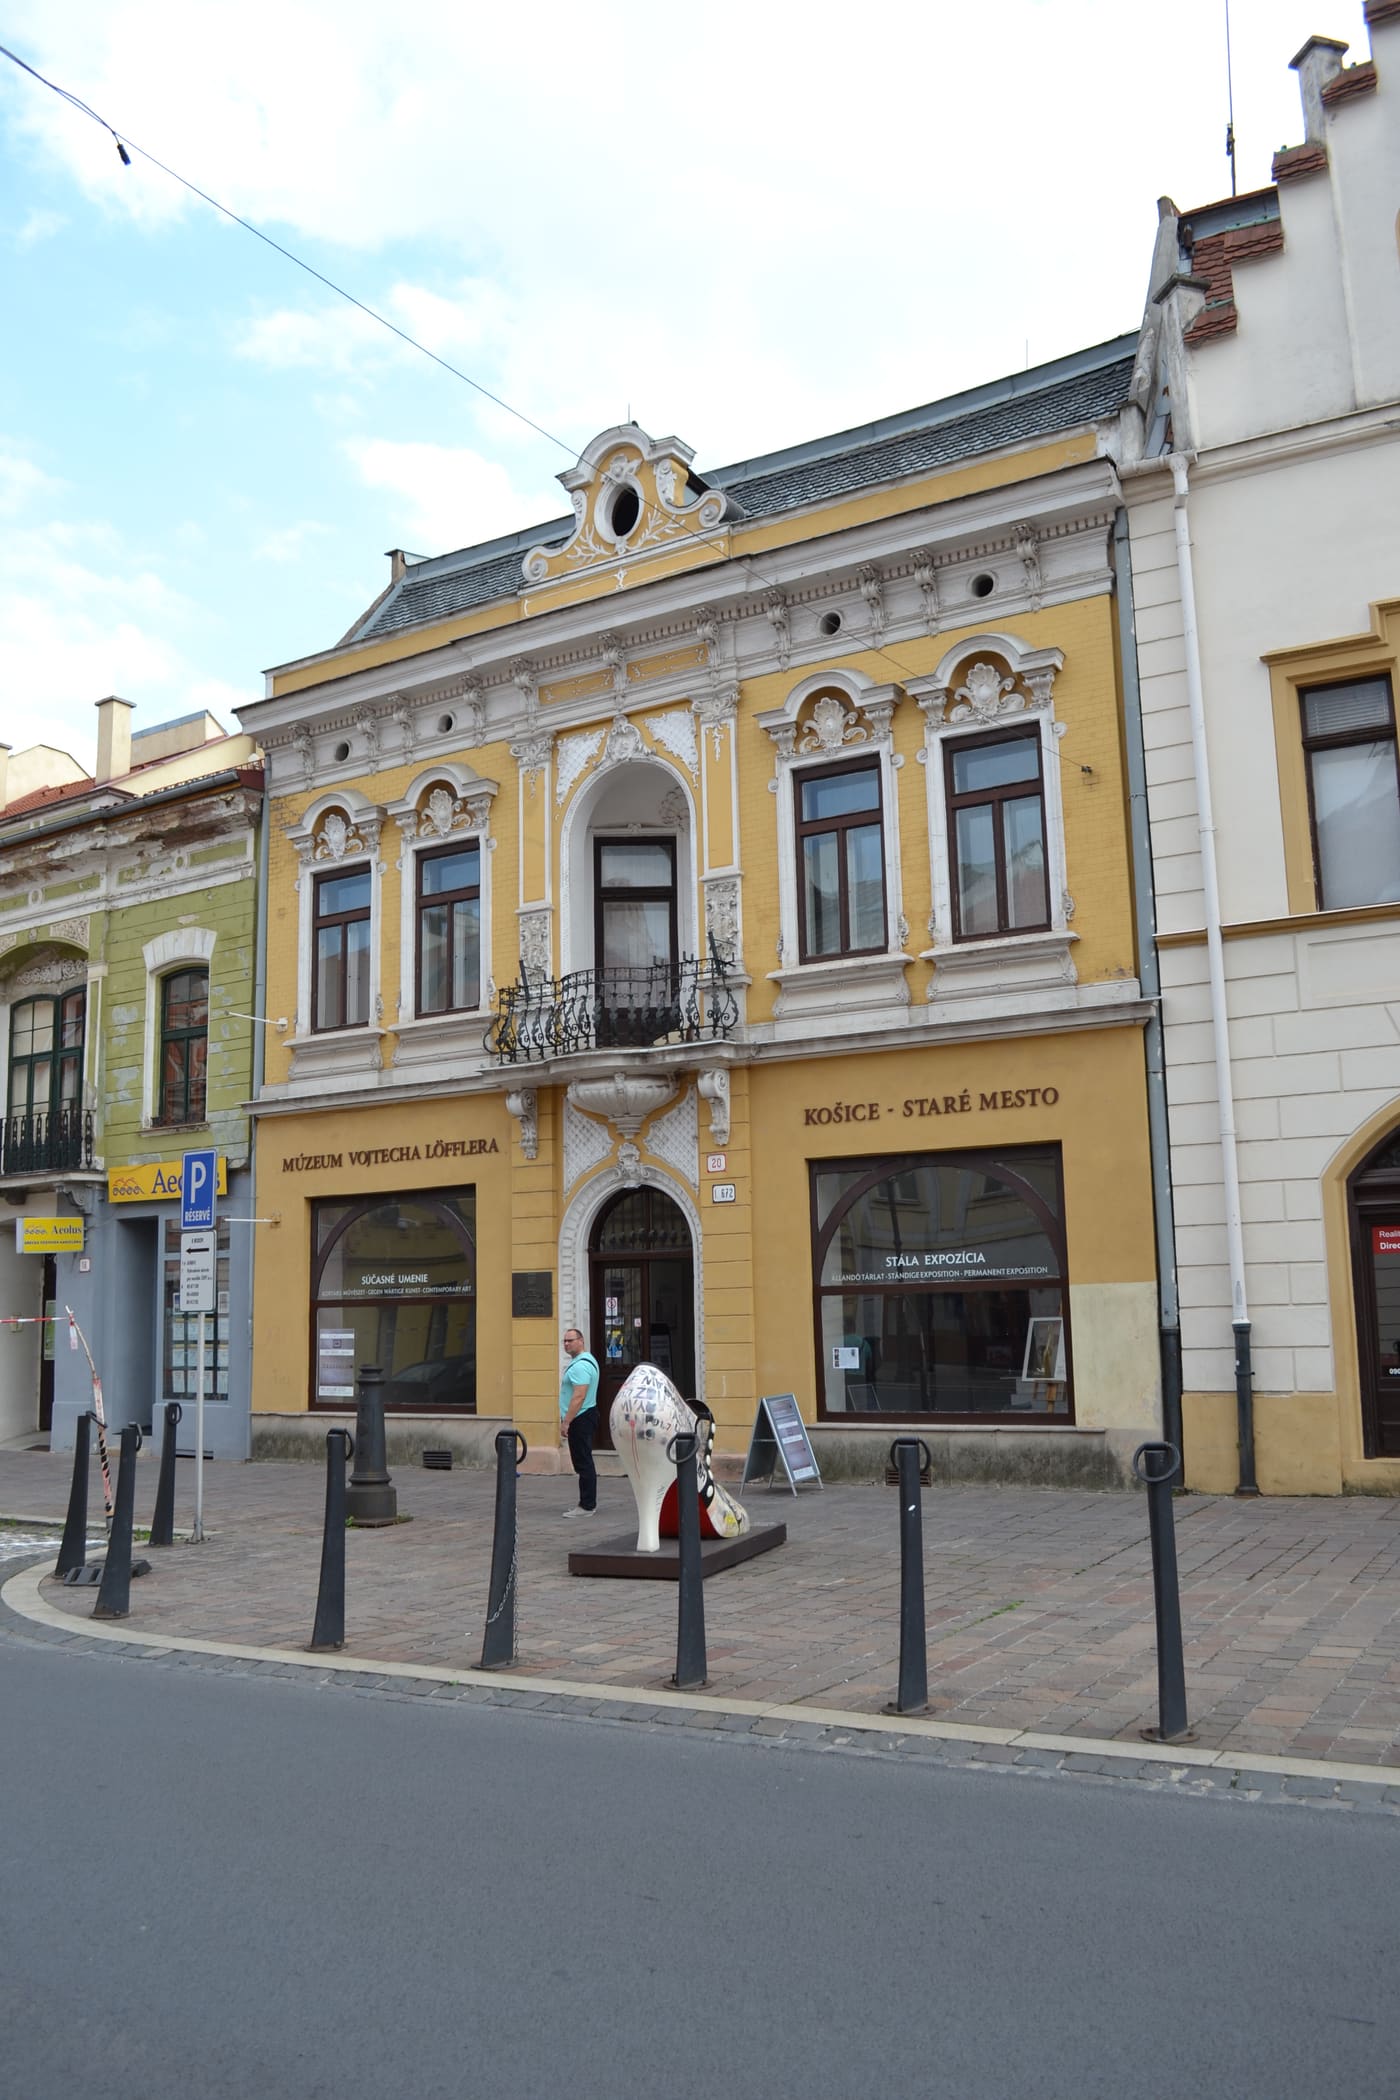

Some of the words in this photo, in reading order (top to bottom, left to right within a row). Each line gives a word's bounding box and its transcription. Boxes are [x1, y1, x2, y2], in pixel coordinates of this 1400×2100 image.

[804, 1102, 880, 1126] KOŠICE
[903, 1089, 972, 1117] STARÉ
[979, 1087, 1060, 1111] MESTO
[282, 1153, 344, 1172] MÚZEUM
[349, 1145, 422, 1168] VOJTECHA
[425, 1139, 499, 1159] LÖFFLERA
[711, 1158, 721, 1169] 20
[190, 1161, 207, 1204] P
[185, 1206, 211, 1222] RÉSERVÉ
[53, 1224, 82, 1235] Aeolus
[885, 1254, 919, 1267] STÁLA
[924, 1251, 986, 1266] EXPOZÍCIA
[361, 1274, 395, 1285] SÚČASNÉ
[398, 1273, 429, 1284] UMENIE
[964, 1267, 1005, 1277] PERMANENT
[1006, 1265, 1048, 1275] EXPOSITION
